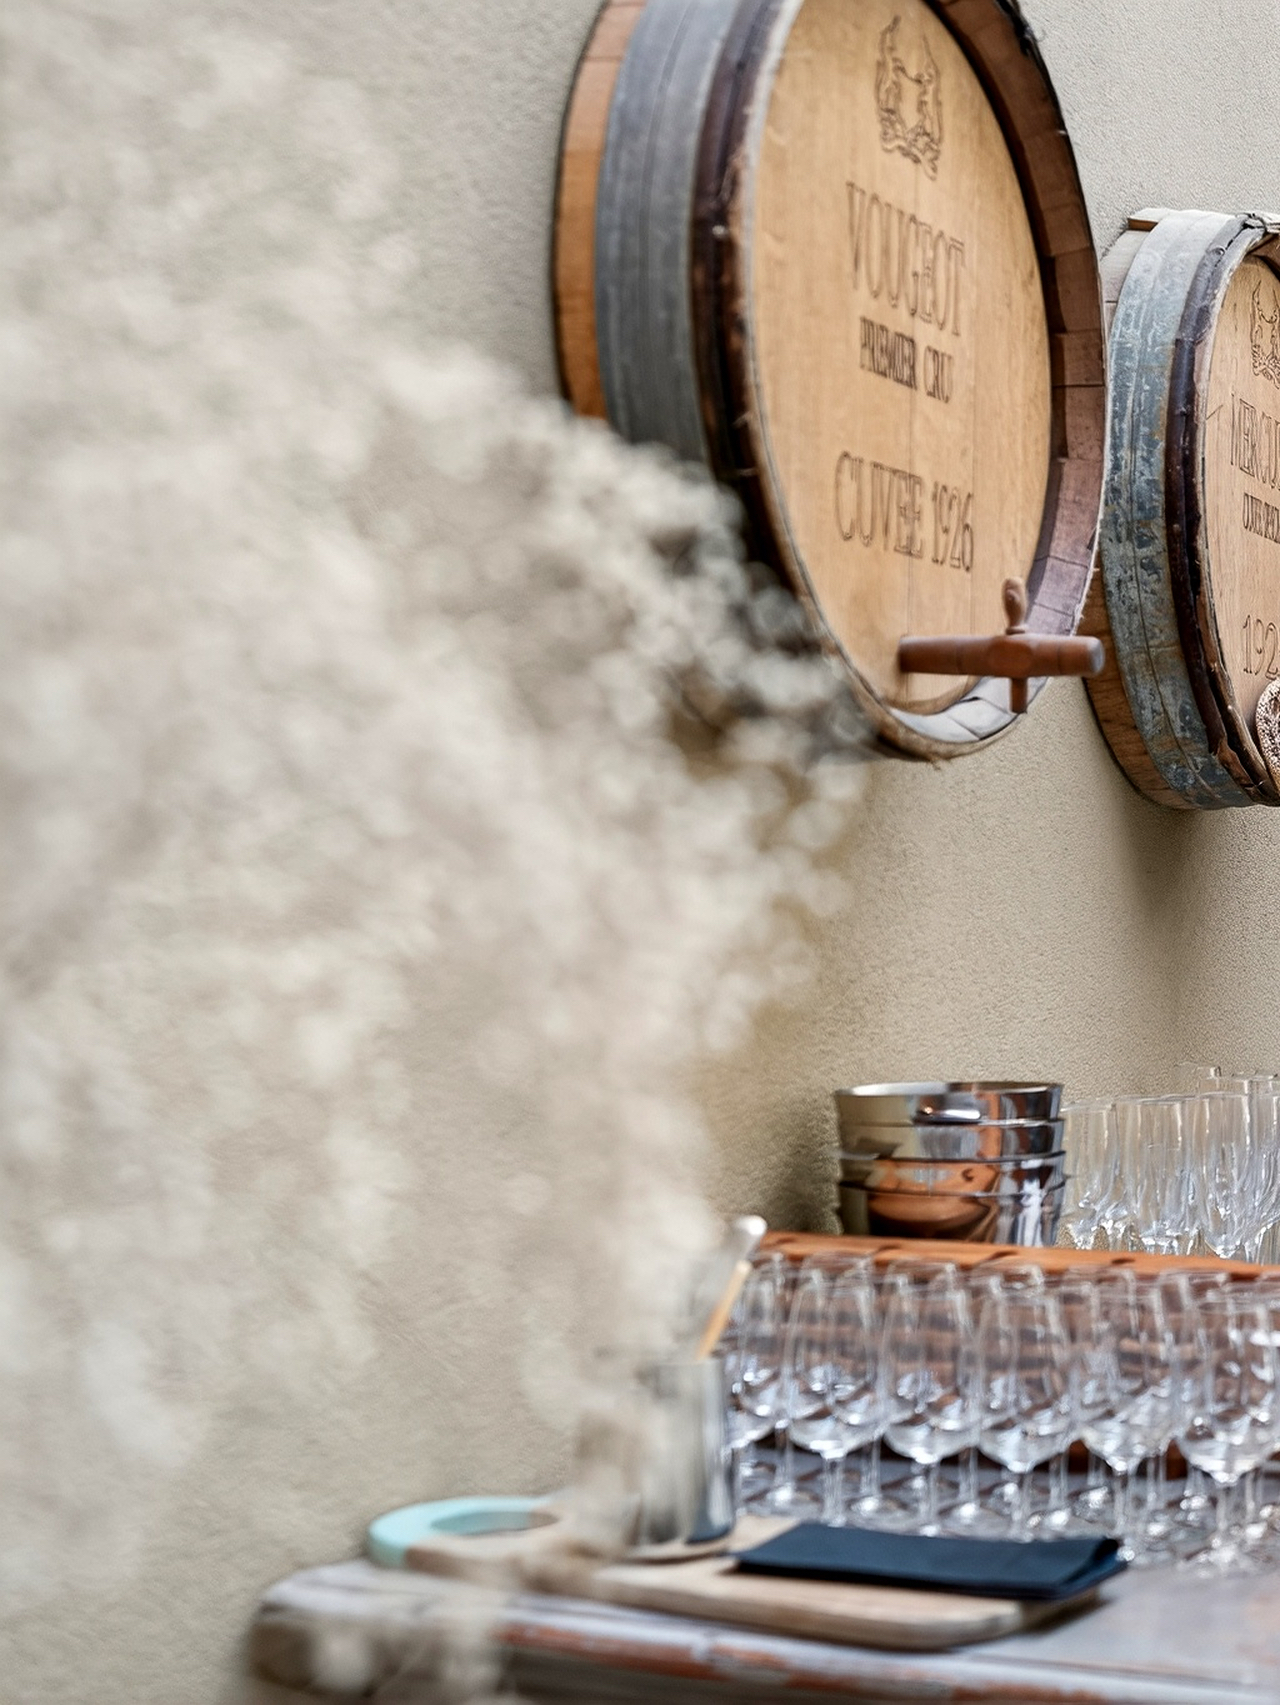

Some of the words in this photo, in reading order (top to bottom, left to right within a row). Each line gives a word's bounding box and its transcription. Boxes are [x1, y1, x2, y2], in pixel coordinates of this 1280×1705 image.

[846, 181, 964, 336] VOUGEOT
[860, 316, 918, 391] PREMIER
[924, 345, 953, 404] CRU
[835, 451, 924, 559] CUVEE
[932, 480, 973, 573] 1926
